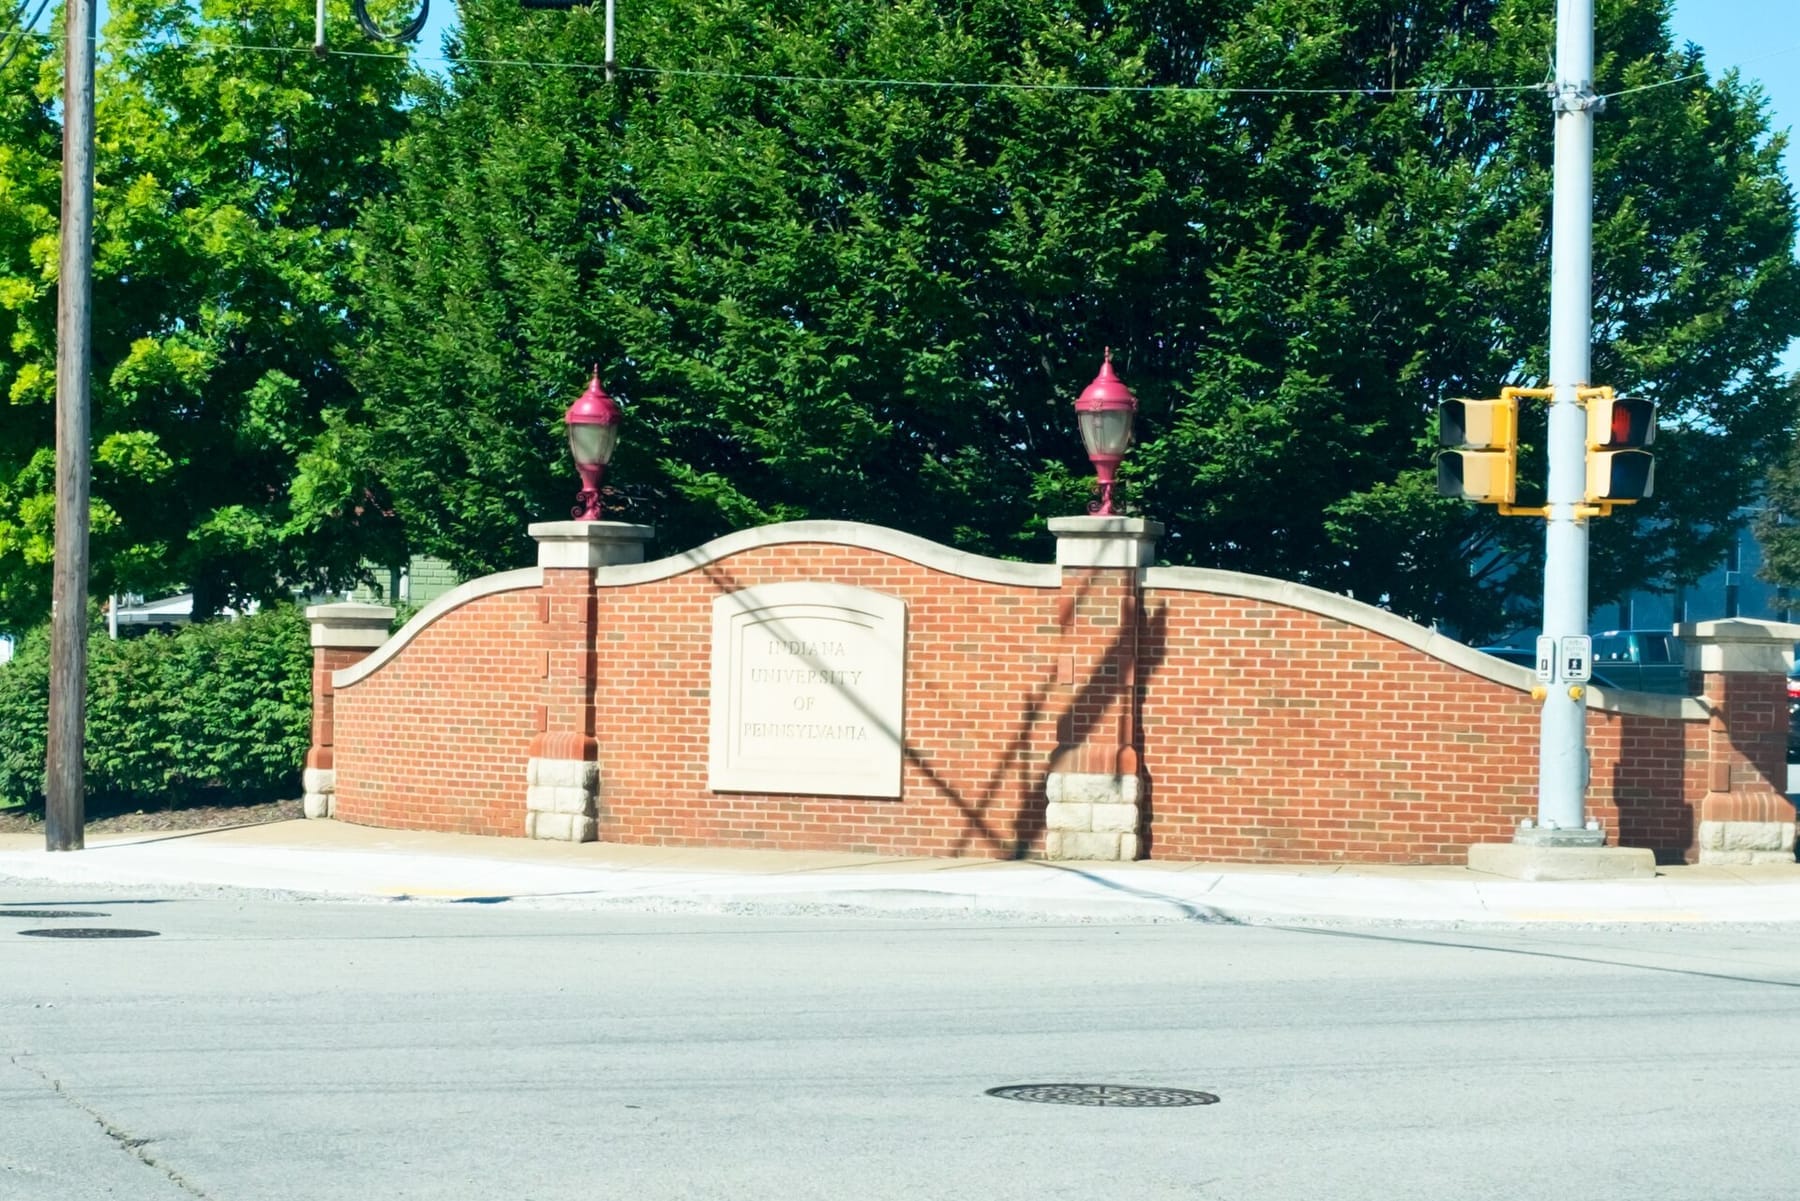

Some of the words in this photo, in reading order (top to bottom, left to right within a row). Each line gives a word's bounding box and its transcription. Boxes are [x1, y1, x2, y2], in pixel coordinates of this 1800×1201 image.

[768, 640, 846, 657] INDIANA
[751, 667, 863, 685] UNIVERSITY
[793, 695, 815, 712] OF
[743, 722, 868, 741] PENNSYLVANIA
